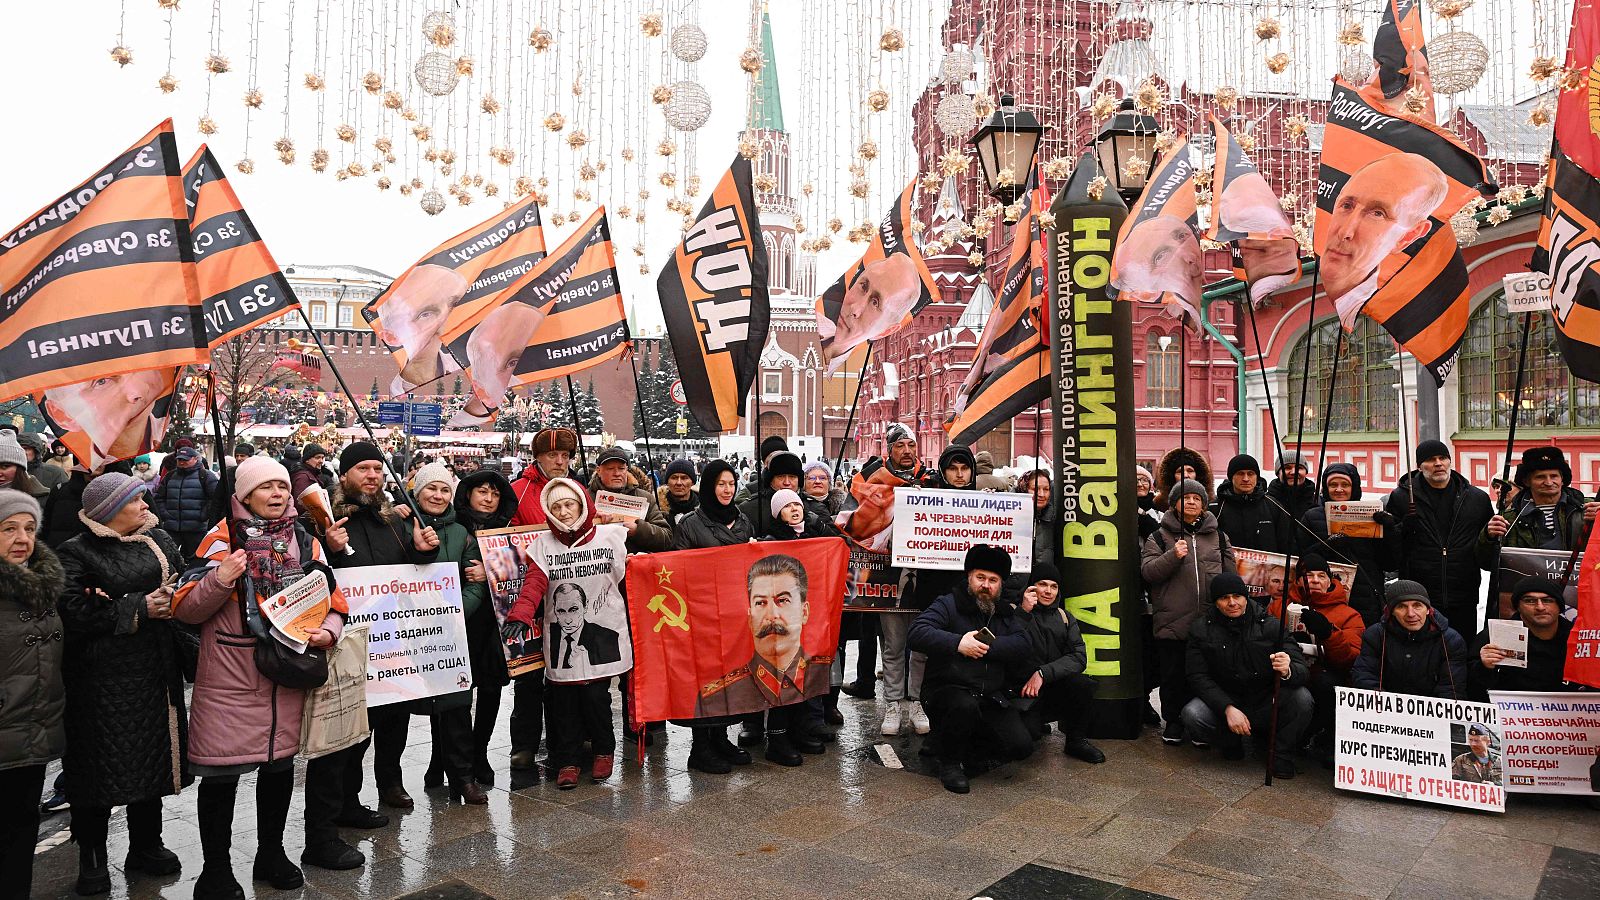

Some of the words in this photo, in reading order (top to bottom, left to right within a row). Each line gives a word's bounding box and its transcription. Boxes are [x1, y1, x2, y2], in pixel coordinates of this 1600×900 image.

[685, 207, 752, 351] НОД
[1056, 231, 1073, 320] задания
[1514, 294, 1551, 306] подпи
[1058, 323, 1075, 430] полётные
[1063, 217, 1120, 560] Вашингтон
[1062, 435, 1081, 522] вернуть
[906, 495, 944, 507] ПУТИН
[952, 497, 979, 509] НАШ
[981, 499, 1022, 511] ЛИДЕР!
[914, 512, 928, 521] ЗА
[929, 513, 1014, 526] ЧРЕЗВЫЧАЙНЫЕ
[914, 526, 989, 538] ПОЛНОМОЧИЯ
[991, 531, 1012, 541] ДЛЯ
[487, 537, 509, 549] МЫ
[511, 535, 520, 545] С
[906, 540, 970, 552] СКОРЕЙШЕЙ
[849, 562, 884, 570] РОССИИ!
[370, 576, 455, 596] победить?!
[382, 605, 461, 621] восстановить
[394, 626, 443, 640] задания
[369, 649, 412, 661] Ельциным
[420, 643, 437, 654] 1994
[439, 642, 457, 652] году)
[1574, 643, 1591, 658] ЗА
[377, 665, 419, 681] ракеты
[422, 662, 435, 672] на
[437, 656, 466, 670] США!
[1339, 690, 1393, 713] РОДИНА
[1396, 697, 1404, 714] В
[1407, 698, 1497, 724] ОПАСНОСТИ!
[1497, 702, 1533, 711] ПУТИН
[1541, 702, 1569, 711] НАШ
[1501, 717, 1517, 726] ЗА
[1352, 720, 1434, 739] ПОДДЕРЖИВАЕМ
[1505, 731, 1588, 741] ПОЛНОМОЧИЯ
[1340, 740, 1368, 757] КУРС
[1371, 744, 1447, 768] ПРЕЗИДЕНТА
[1507, 745, 1530, 756] ДЛЯ
[1508, 759, 1559, 770] ПОБЕДЫ!
[1338, 765, 1355, 783] ПО
[1361, 768, 1413, 793] ЗАЩИТЕ
[1419, 777, 1501, 806] ОТЕЧЕСТВА!
[1513, 776, 1532, 785] НОД
